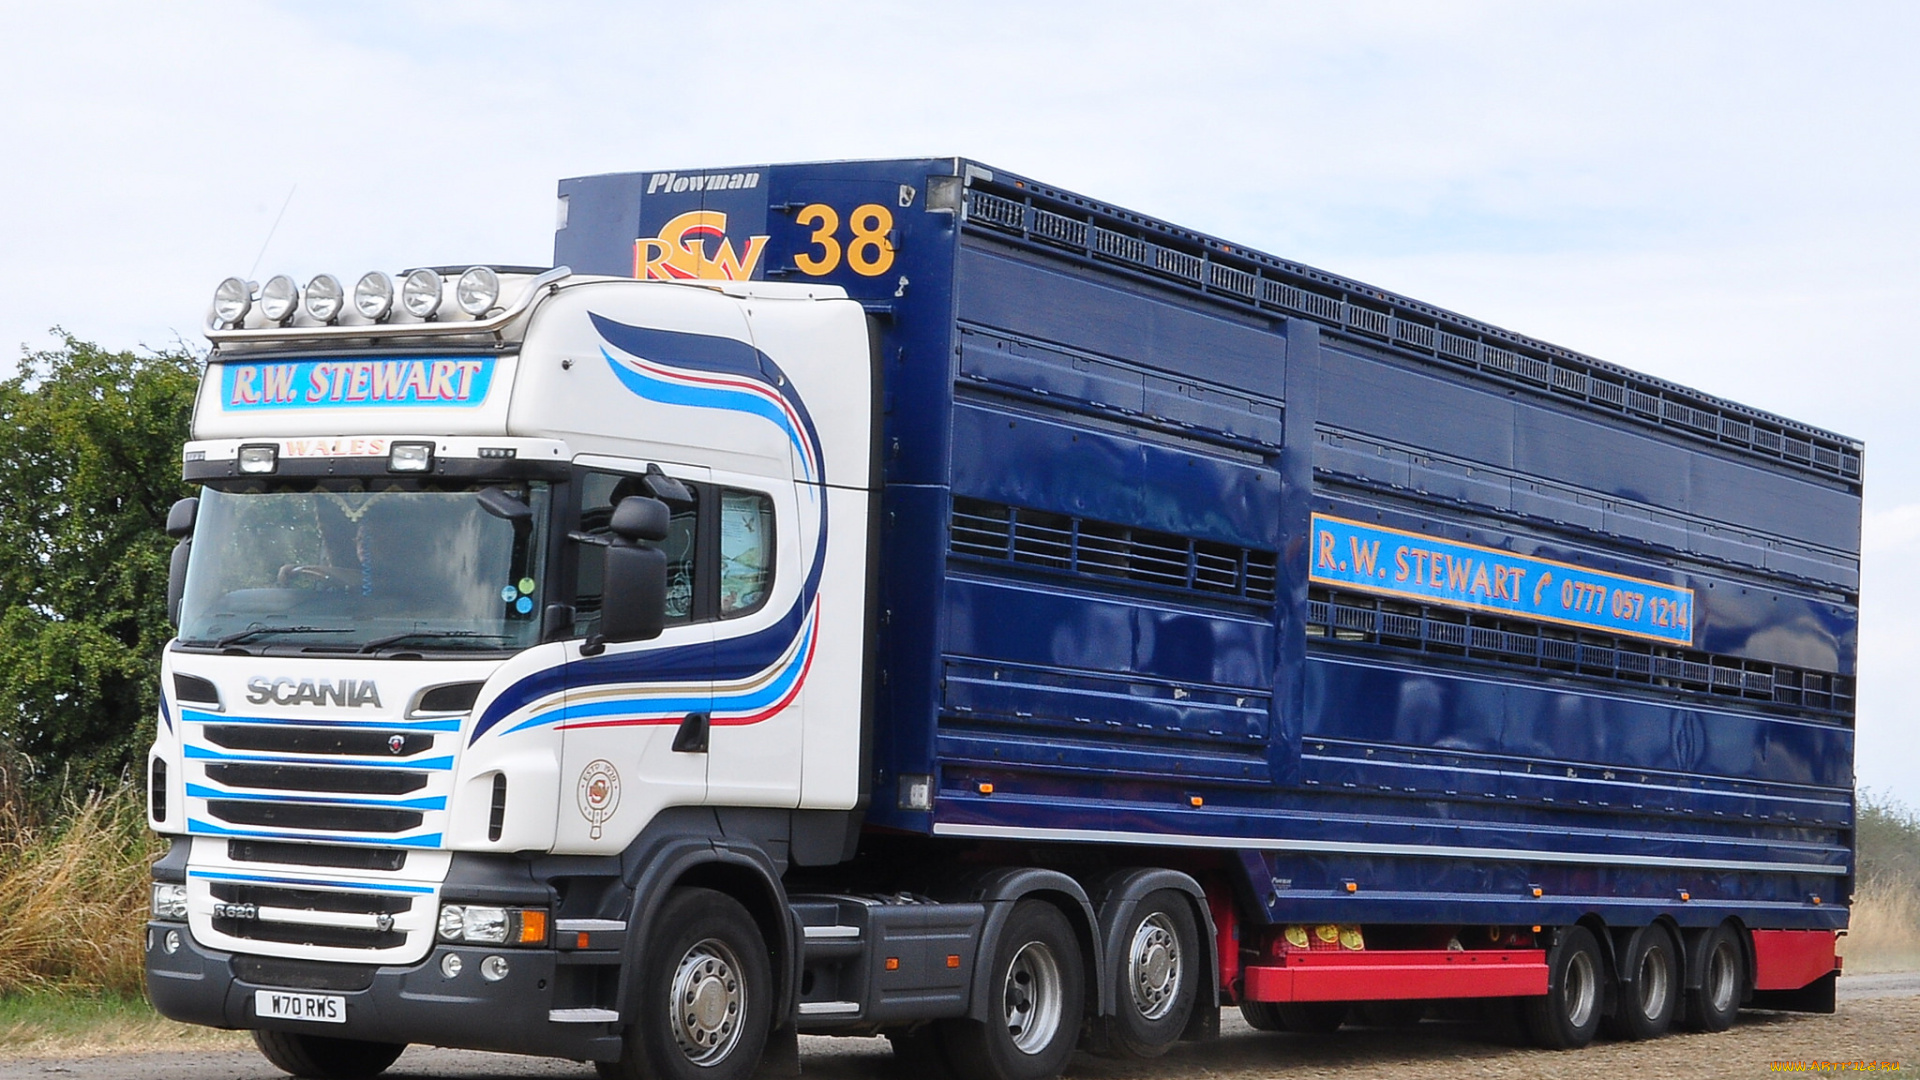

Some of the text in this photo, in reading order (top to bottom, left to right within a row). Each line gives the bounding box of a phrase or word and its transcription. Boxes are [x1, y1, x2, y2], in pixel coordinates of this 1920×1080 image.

[647, 172, 760, 194] Plowman
[794, 203, 895, 276] 38
[231, 360, 483, 405] R.W. STEWART
[286, 439, 385, 456] WALES
[1318, 530, 1688, 631] R.W. STEWART 0777 057 1214
[246, 676, 382, 708] SCANIA
[272, 995, 337, 1018] W70 RWS
